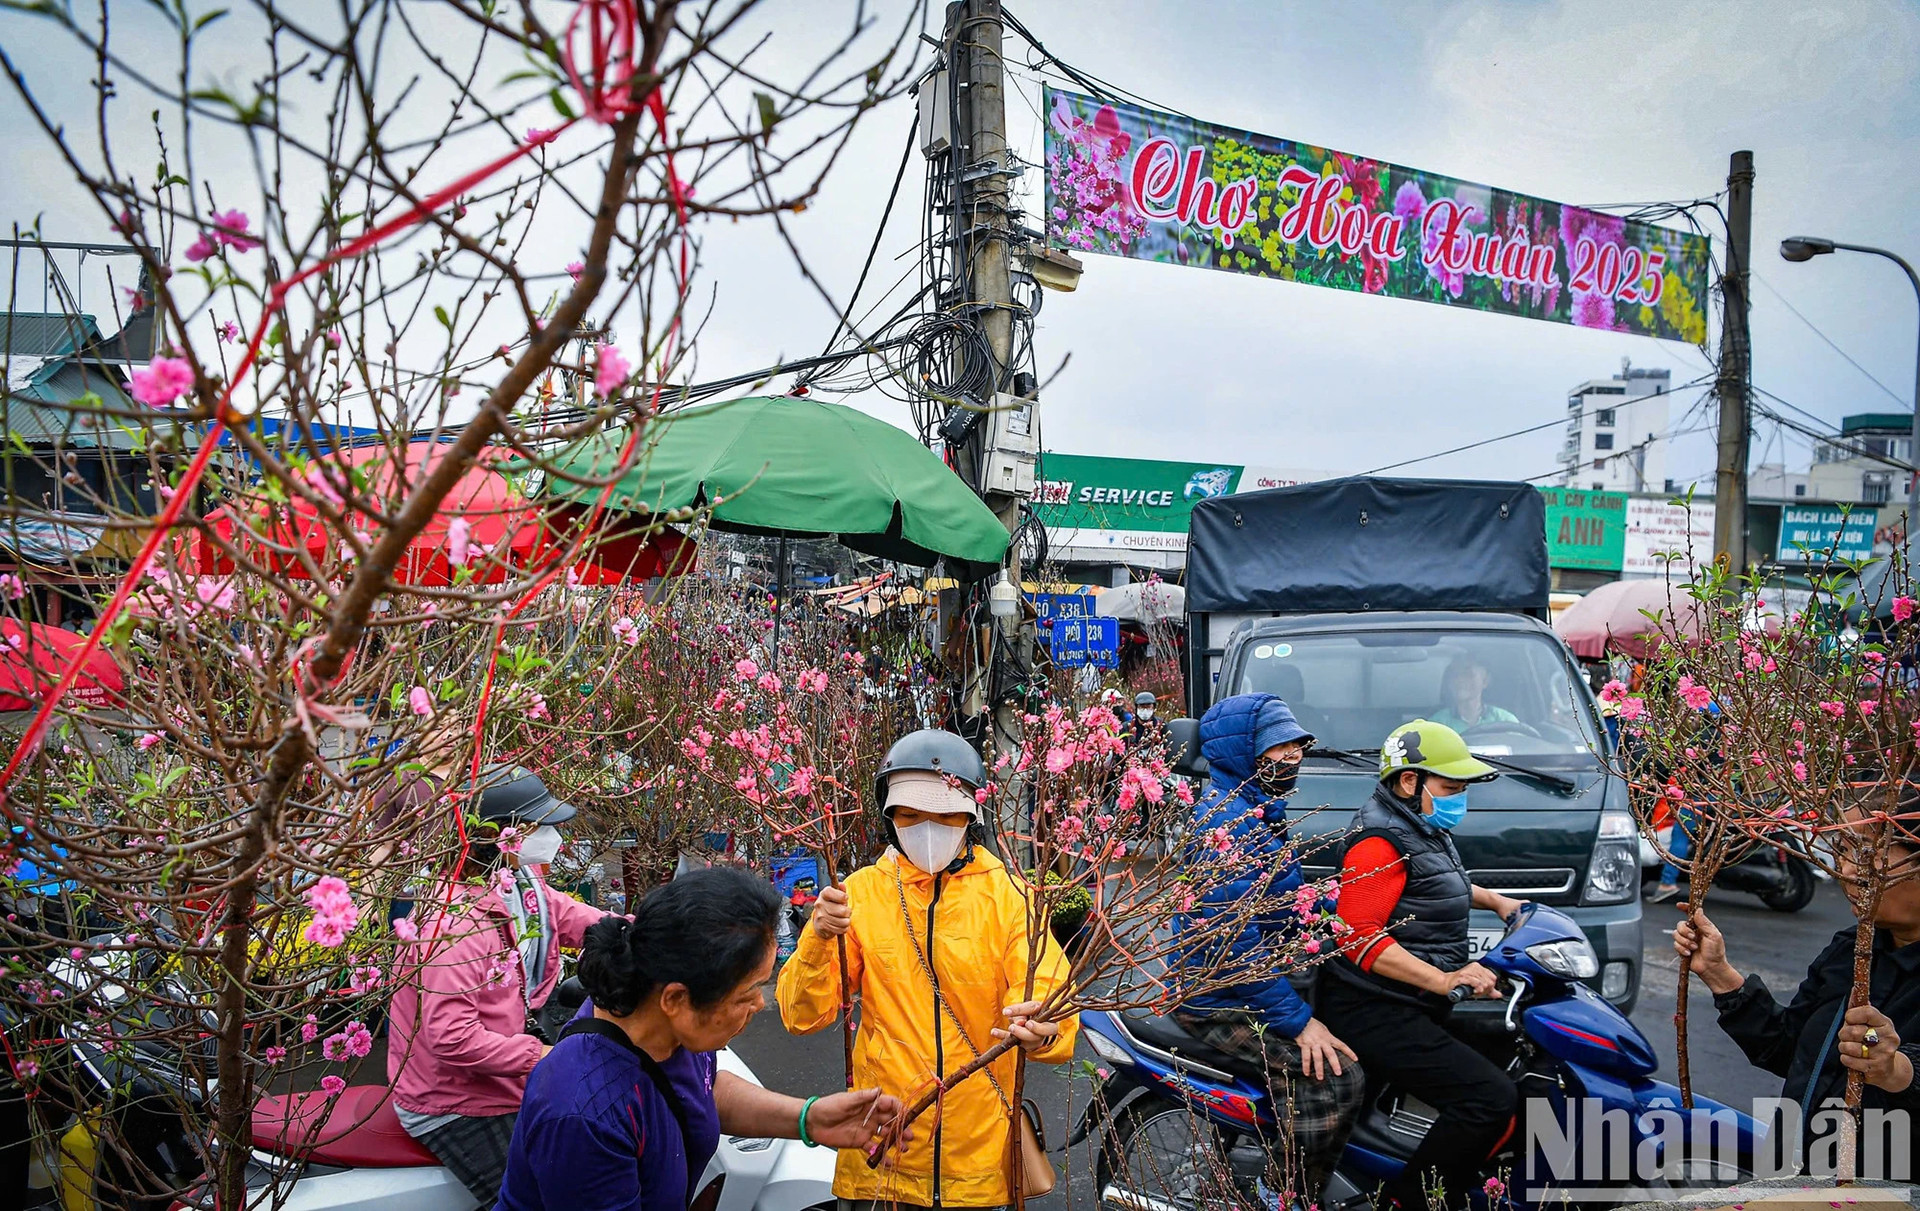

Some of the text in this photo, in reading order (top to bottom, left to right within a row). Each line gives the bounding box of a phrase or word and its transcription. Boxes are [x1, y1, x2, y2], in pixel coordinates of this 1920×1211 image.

[1130, 136, 1668, 306] Chợ Hoa Xuân 2025
[1078, 486, 1173, 506] SERVICE
[1786, 510, 1818, 523] BÁCH
[1122, 534, 1163, 546] CHUYÊN
[1557, 515, 1605, 547] ANH
[1035, 599, 1050, 618] GÕ
[1087, 624, 1103, 641] 238
